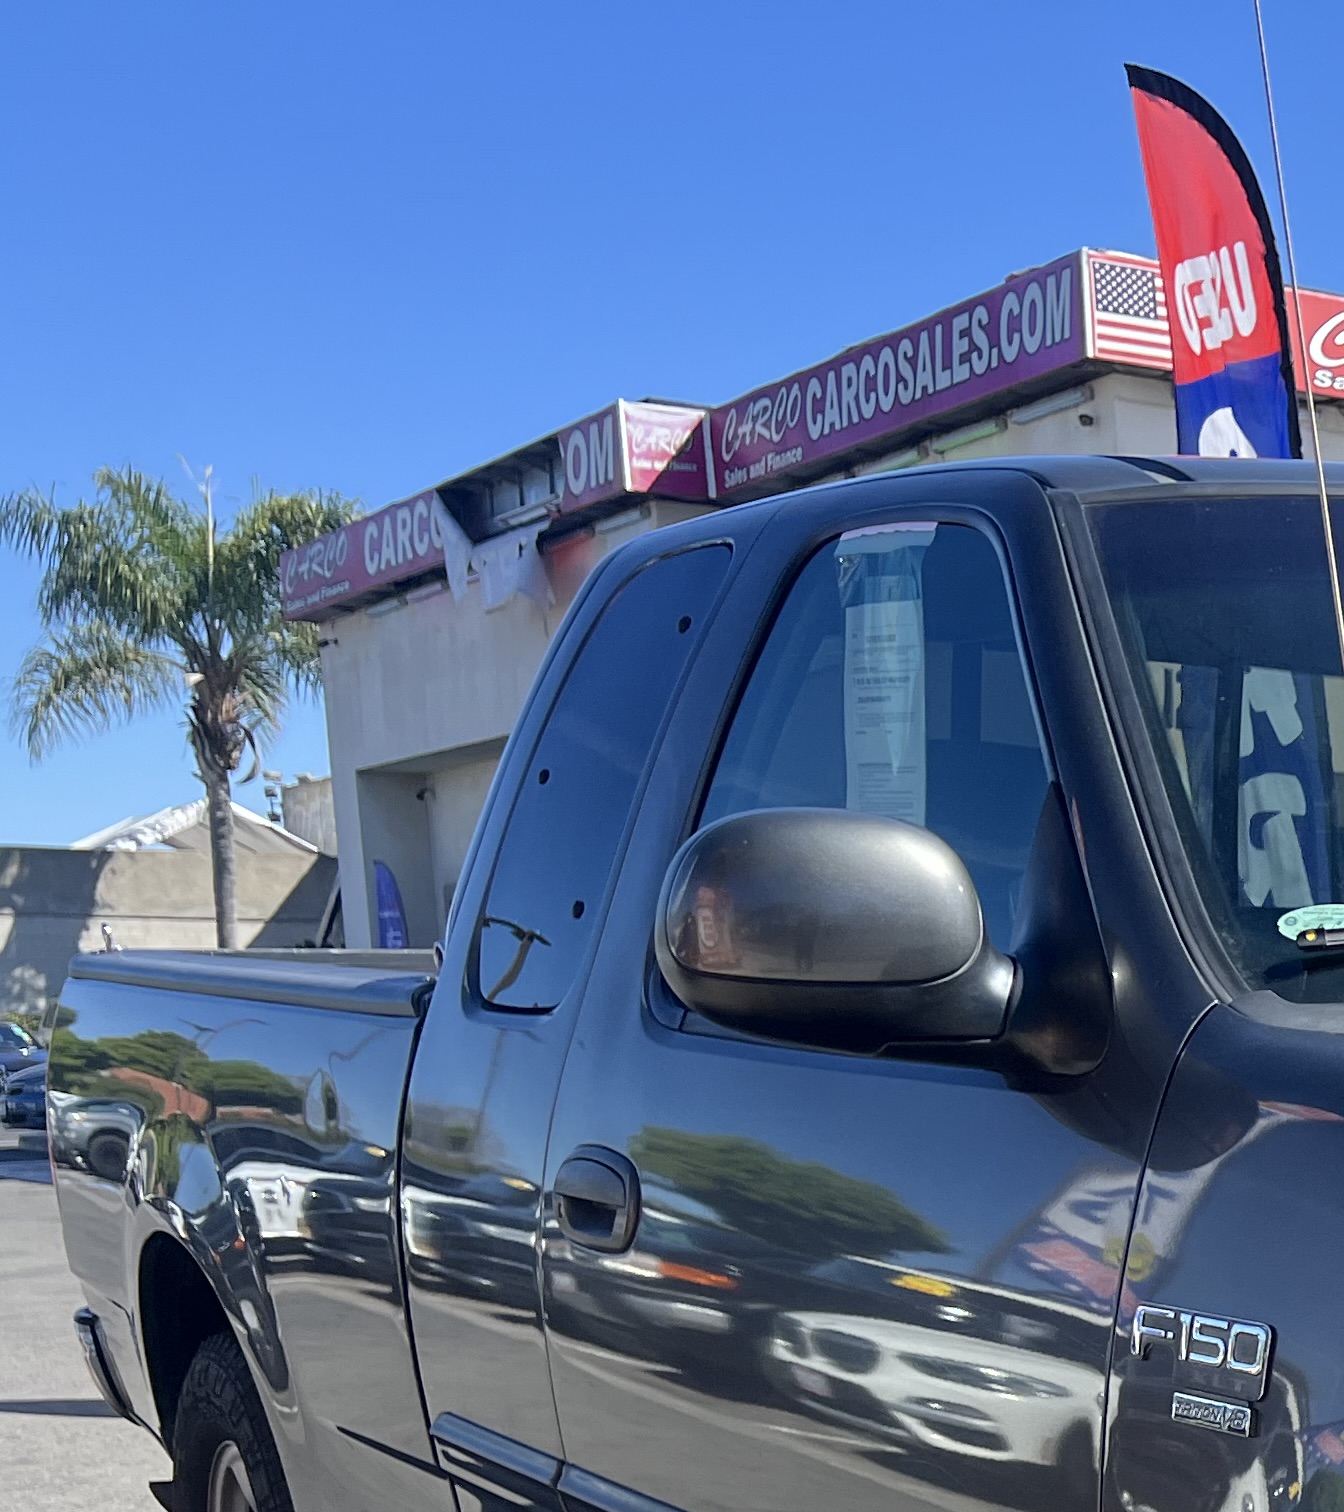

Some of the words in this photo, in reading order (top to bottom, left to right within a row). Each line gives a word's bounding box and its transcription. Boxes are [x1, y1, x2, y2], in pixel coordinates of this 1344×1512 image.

[805, 267, 1073, 441] CARCOSALES.COM
[558, 414, 614, 496] OM
[722, 382, 801, 463] CARCO
[725, 467, 748, 489] Sales
[750, 460, 766, 479] and
[767, 446, 803, 472] Finance
[285, 531, 347, 594] CARCO
